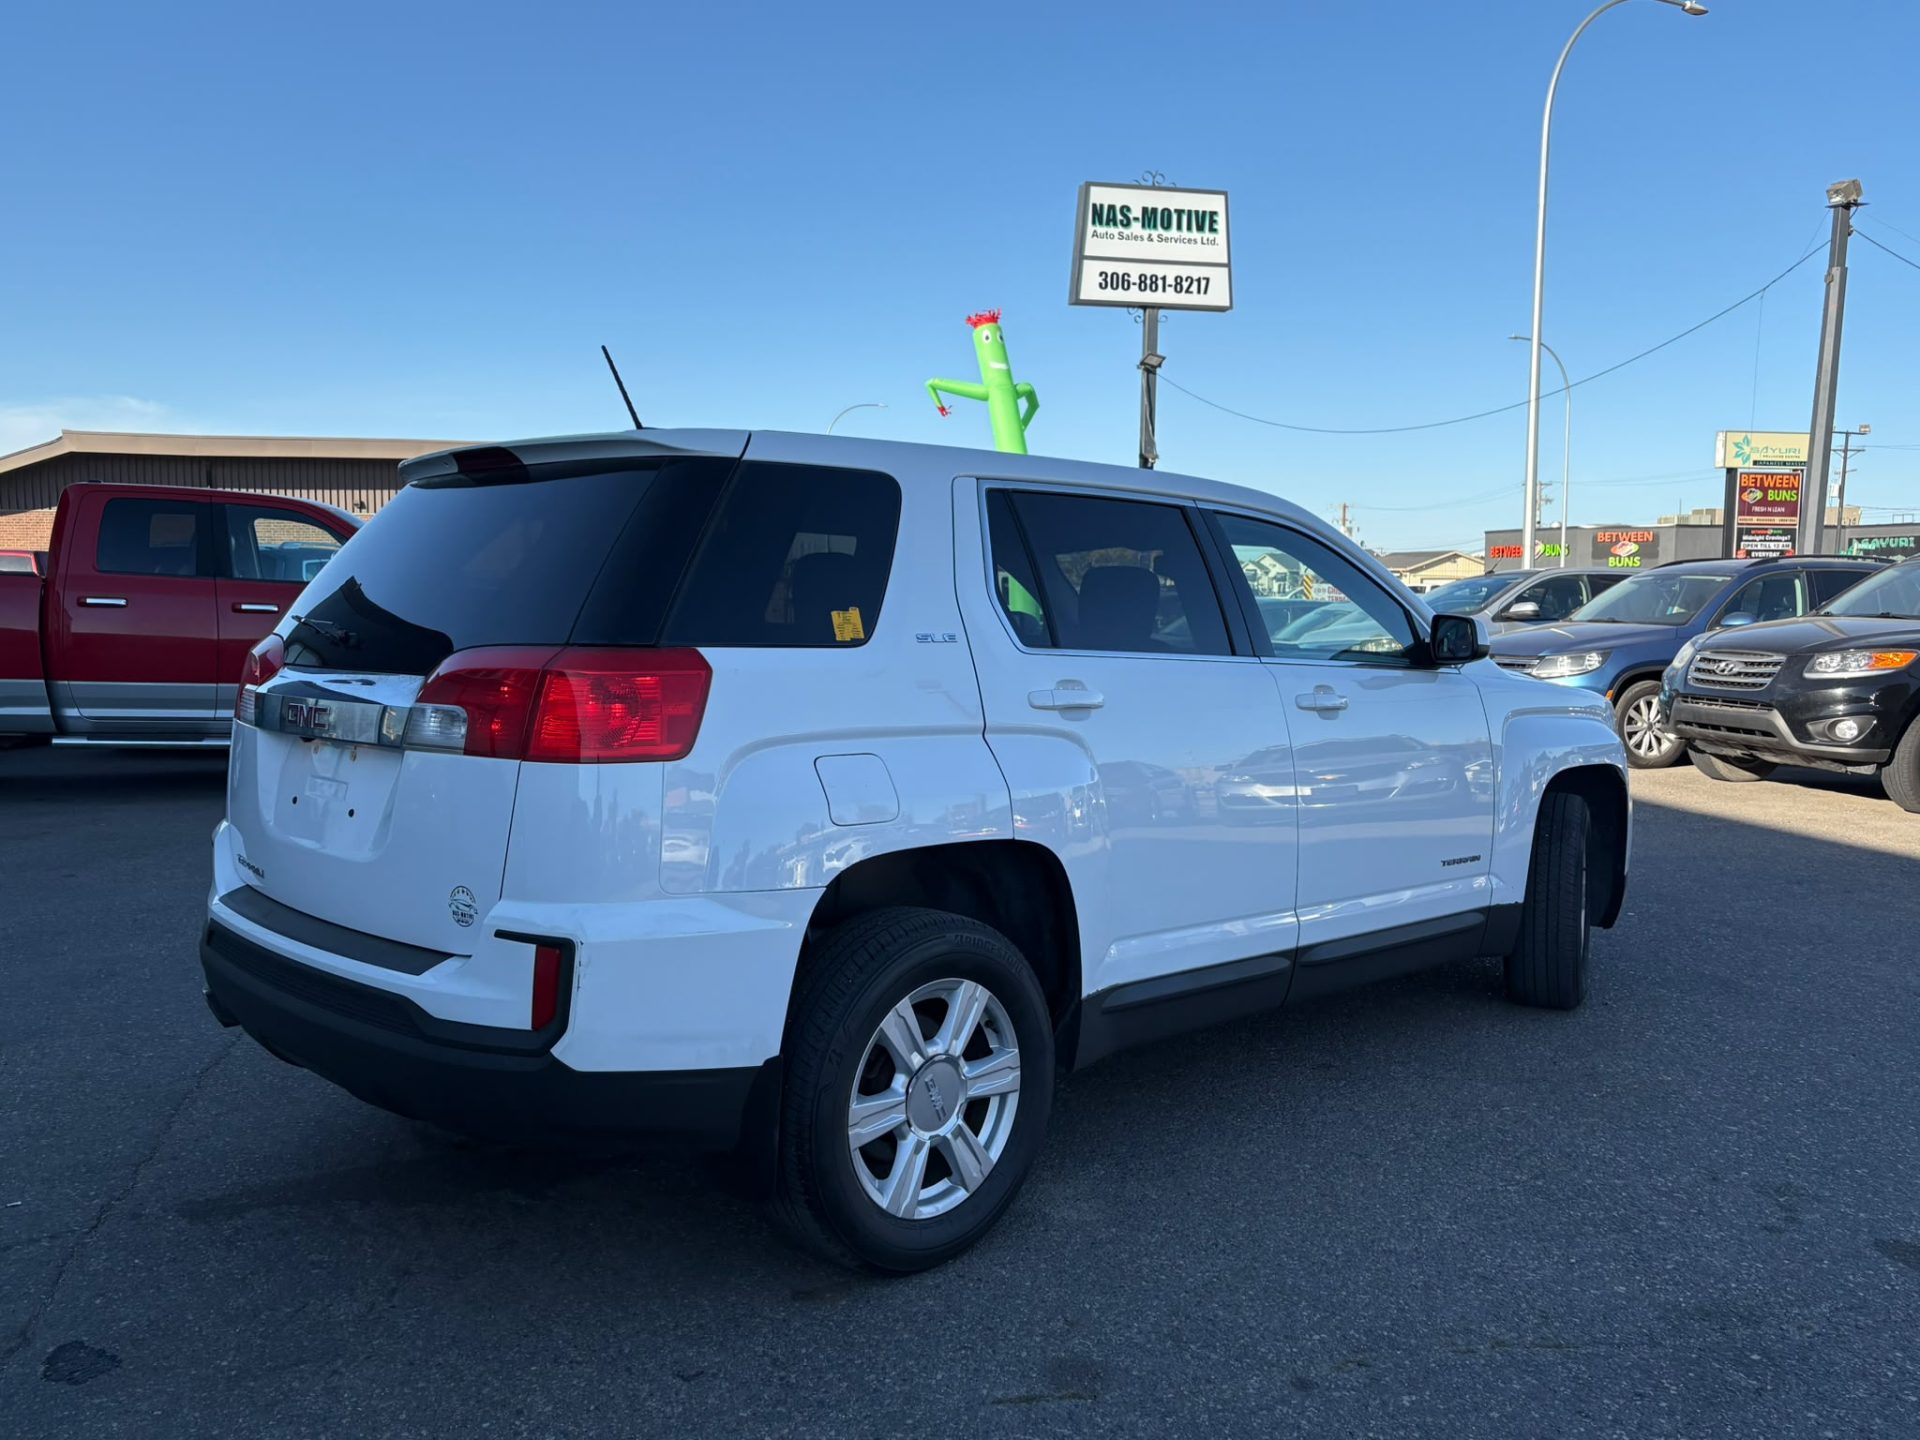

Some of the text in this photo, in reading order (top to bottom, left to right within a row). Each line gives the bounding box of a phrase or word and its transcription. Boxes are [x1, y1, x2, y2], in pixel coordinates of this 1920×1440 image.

[1091, 203, 1219, 233] NAS-MOTIVE
[1091, 229, 1219, 246] Auto Sales & Services Ltd.
[1098, 271, 1210, 295] 306-881-8217
[1741, 474, 1798, 487] BETWEEN
[1768, 489, 1797, 502] BUNS
[1597, 531, 1653, 543] BETWEEN
[1490, 544, 1524, 559] BETWEE
[1608, 556, 1641, 568] BUNS
[288, 702, 330, 730] GMC
